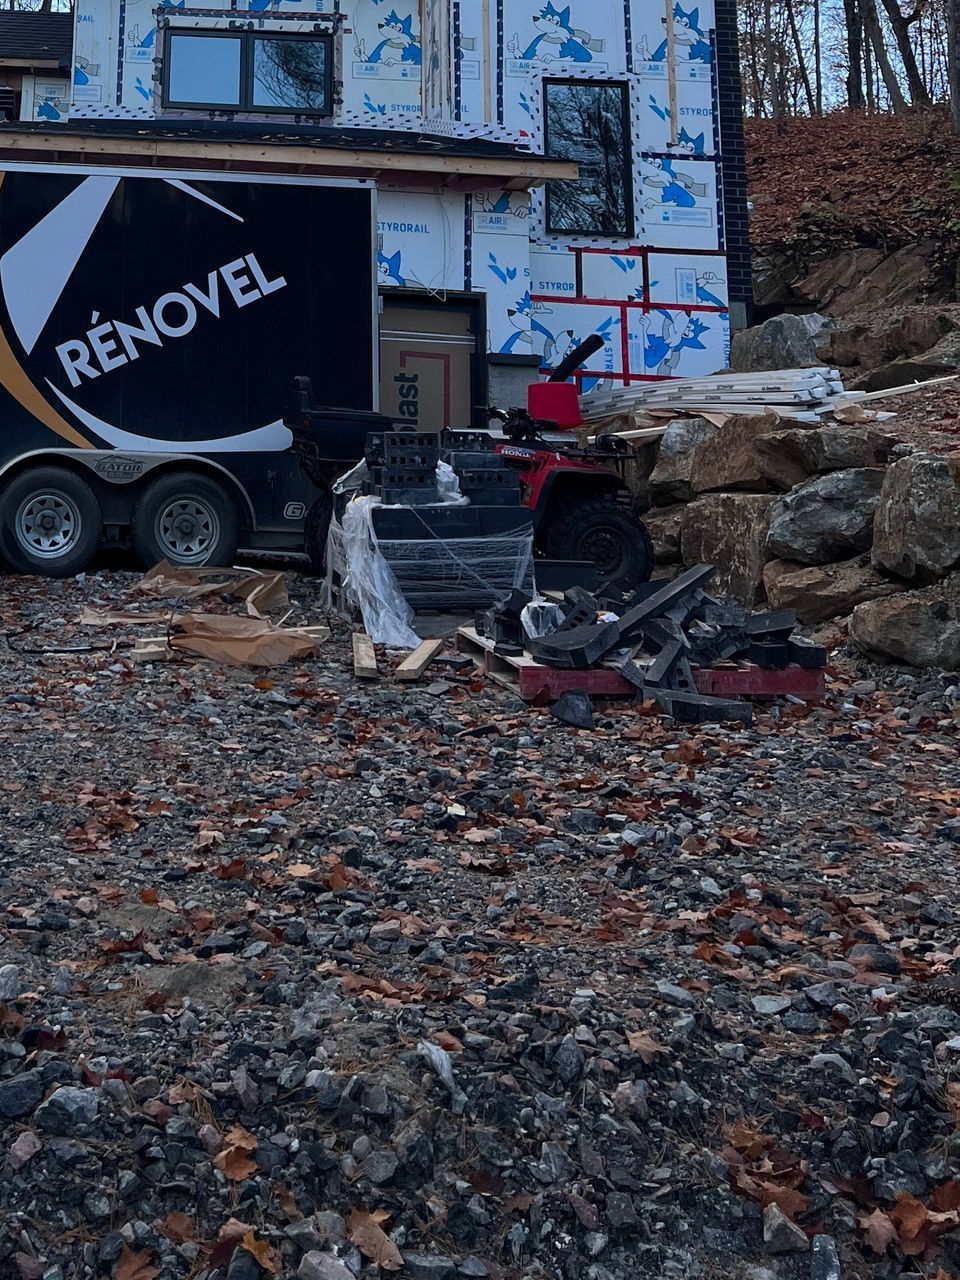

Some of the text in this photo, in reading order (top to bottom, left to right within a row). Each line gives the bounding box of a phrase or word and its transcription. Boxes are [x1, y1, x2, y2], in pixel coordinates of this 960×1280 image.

[489, 216, 502, 225] AIR
[376, 222, 430, 234] STYRORAIL
[538, 281, 575, 292] STYROR
[55, 252, 288, 388] RÉNOVEL
[97, 463, 141, 472] GATOR
